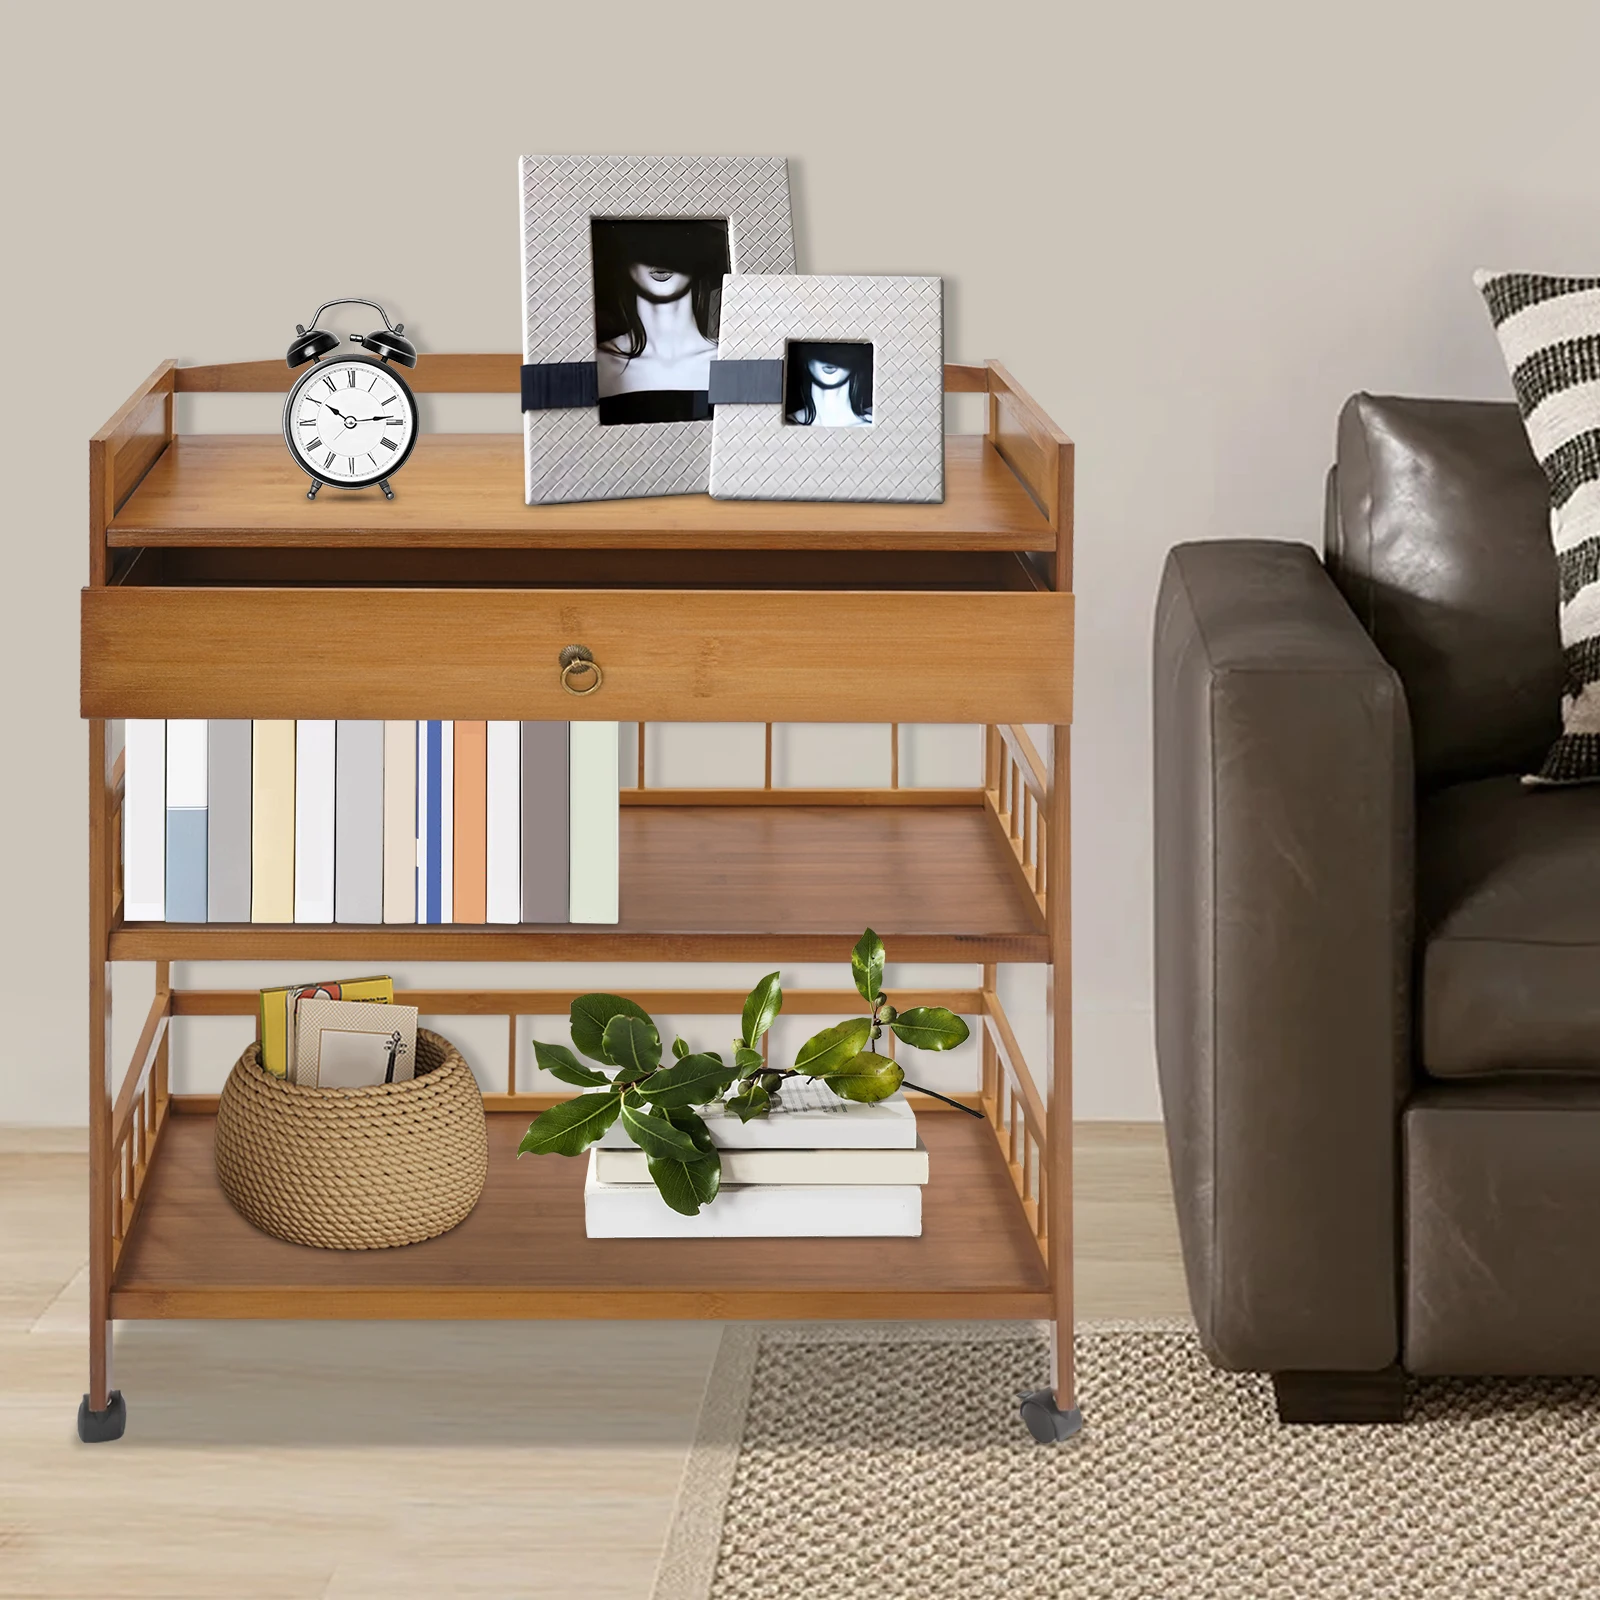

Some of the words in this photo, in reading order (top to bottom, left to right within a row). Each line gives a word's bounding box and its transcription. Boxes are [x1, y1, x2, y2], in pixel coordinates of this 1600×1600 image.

[322, 376, 337, 395] XI
[347, 370, 355, 388] XII
[305, 394, 322, 408] X
[381, 395, 397, 407] II
[299, 418, 317, 427] IX
[305, 436, 323, 452] VIII
[323, 451, 337, 469] VII
